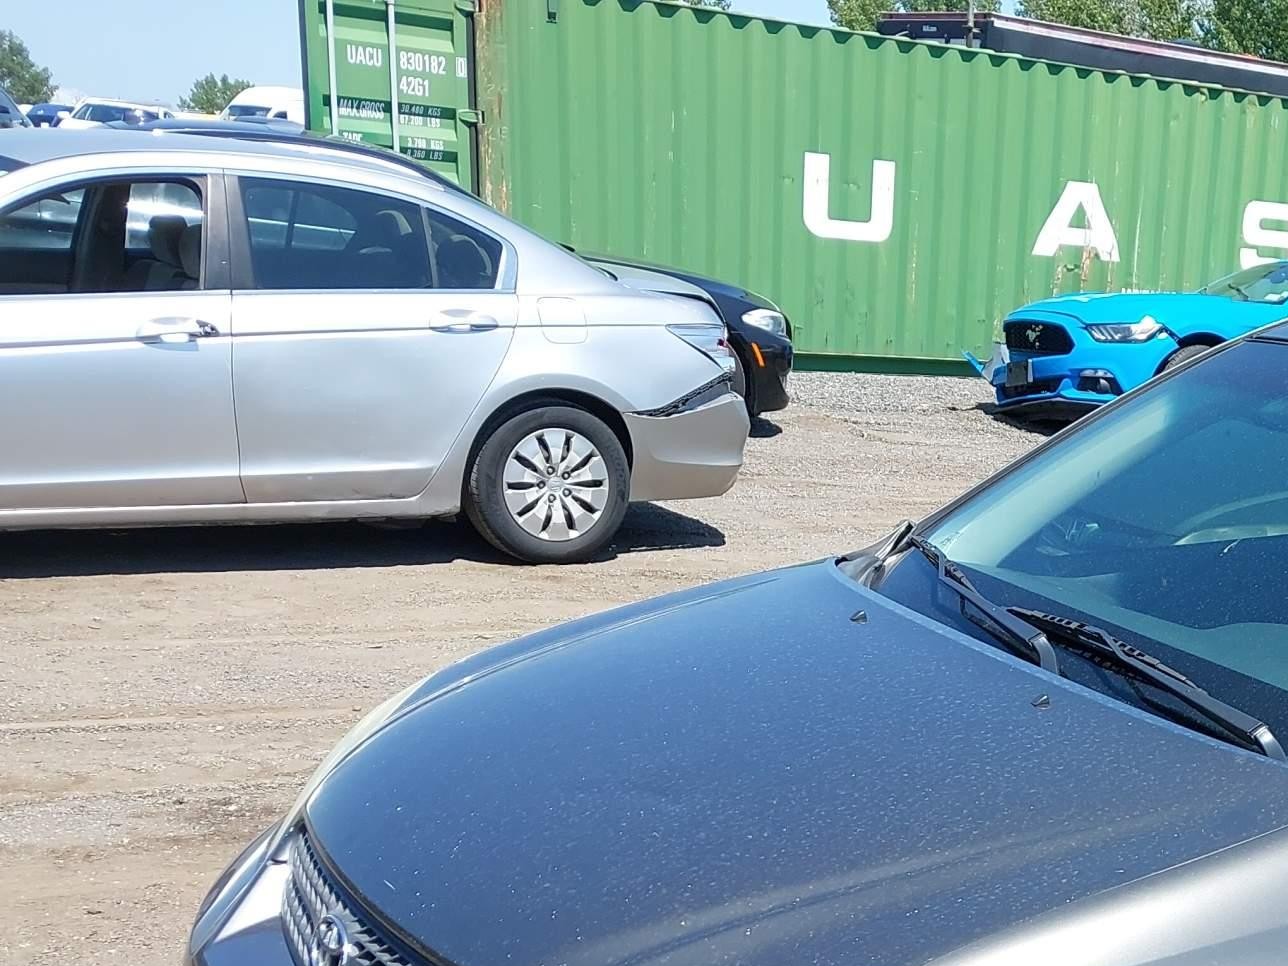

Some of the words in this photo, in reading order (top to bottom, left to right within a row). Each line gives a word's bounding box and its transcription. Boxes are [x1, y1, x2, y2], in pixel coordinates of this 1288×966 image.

[346, 43, 382, 67] UACU
[399, 51, 447, 75] 830182
[399, 75, 429, 97] 42G1
